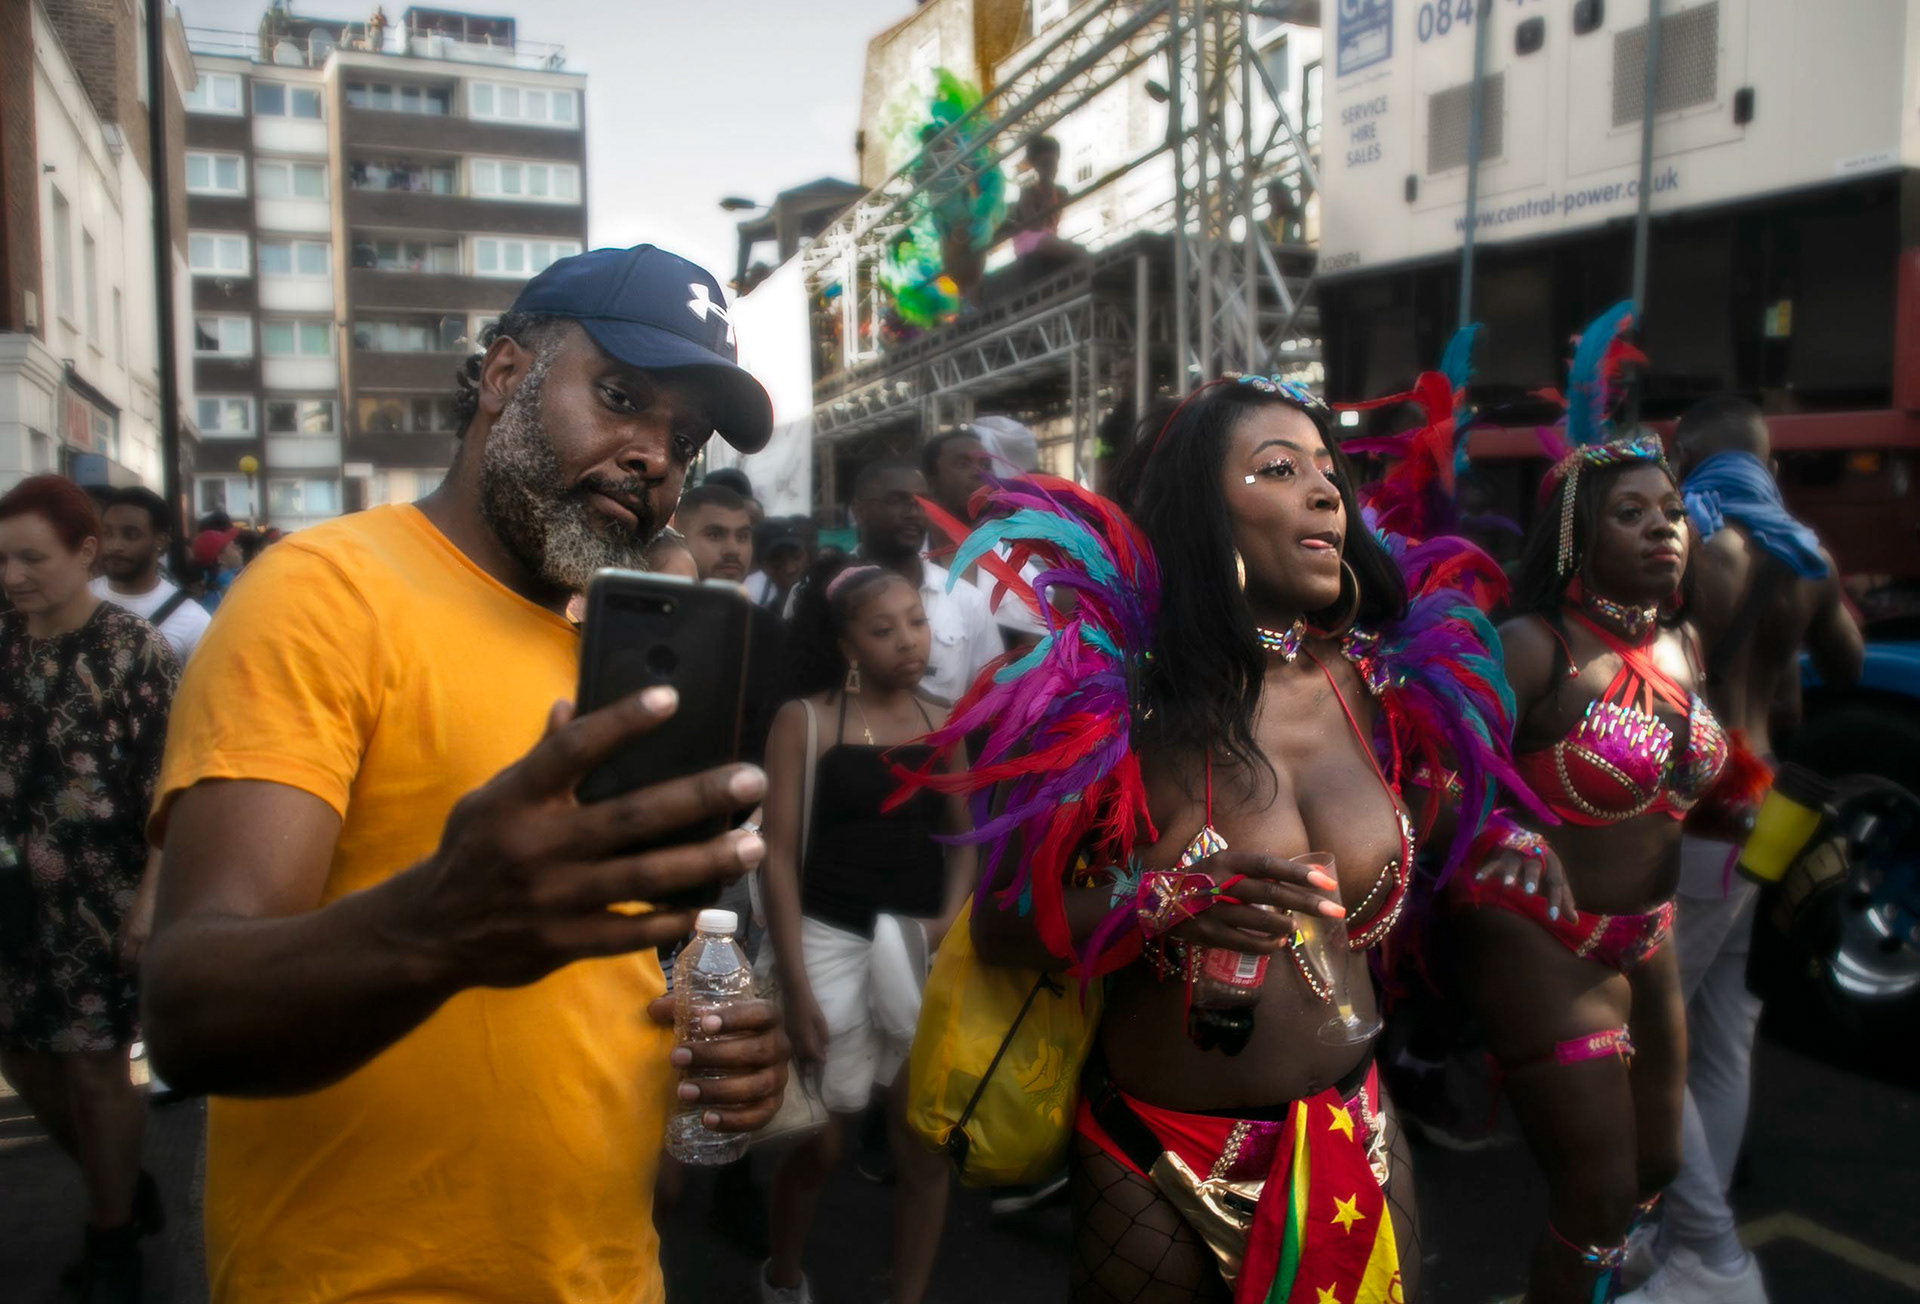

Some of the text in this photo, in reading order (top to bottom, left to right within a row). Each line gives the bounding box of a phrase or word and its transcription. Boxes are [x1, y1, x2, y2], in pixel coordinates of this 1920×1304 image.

[1341, 95, 1388, 125] SERVICE
[1351, 122, 1377, 143] HIRE
[1346, 142, 1382, 168] SALES
[1454, 166, 1679, 233] ww.central-power.c.uk
